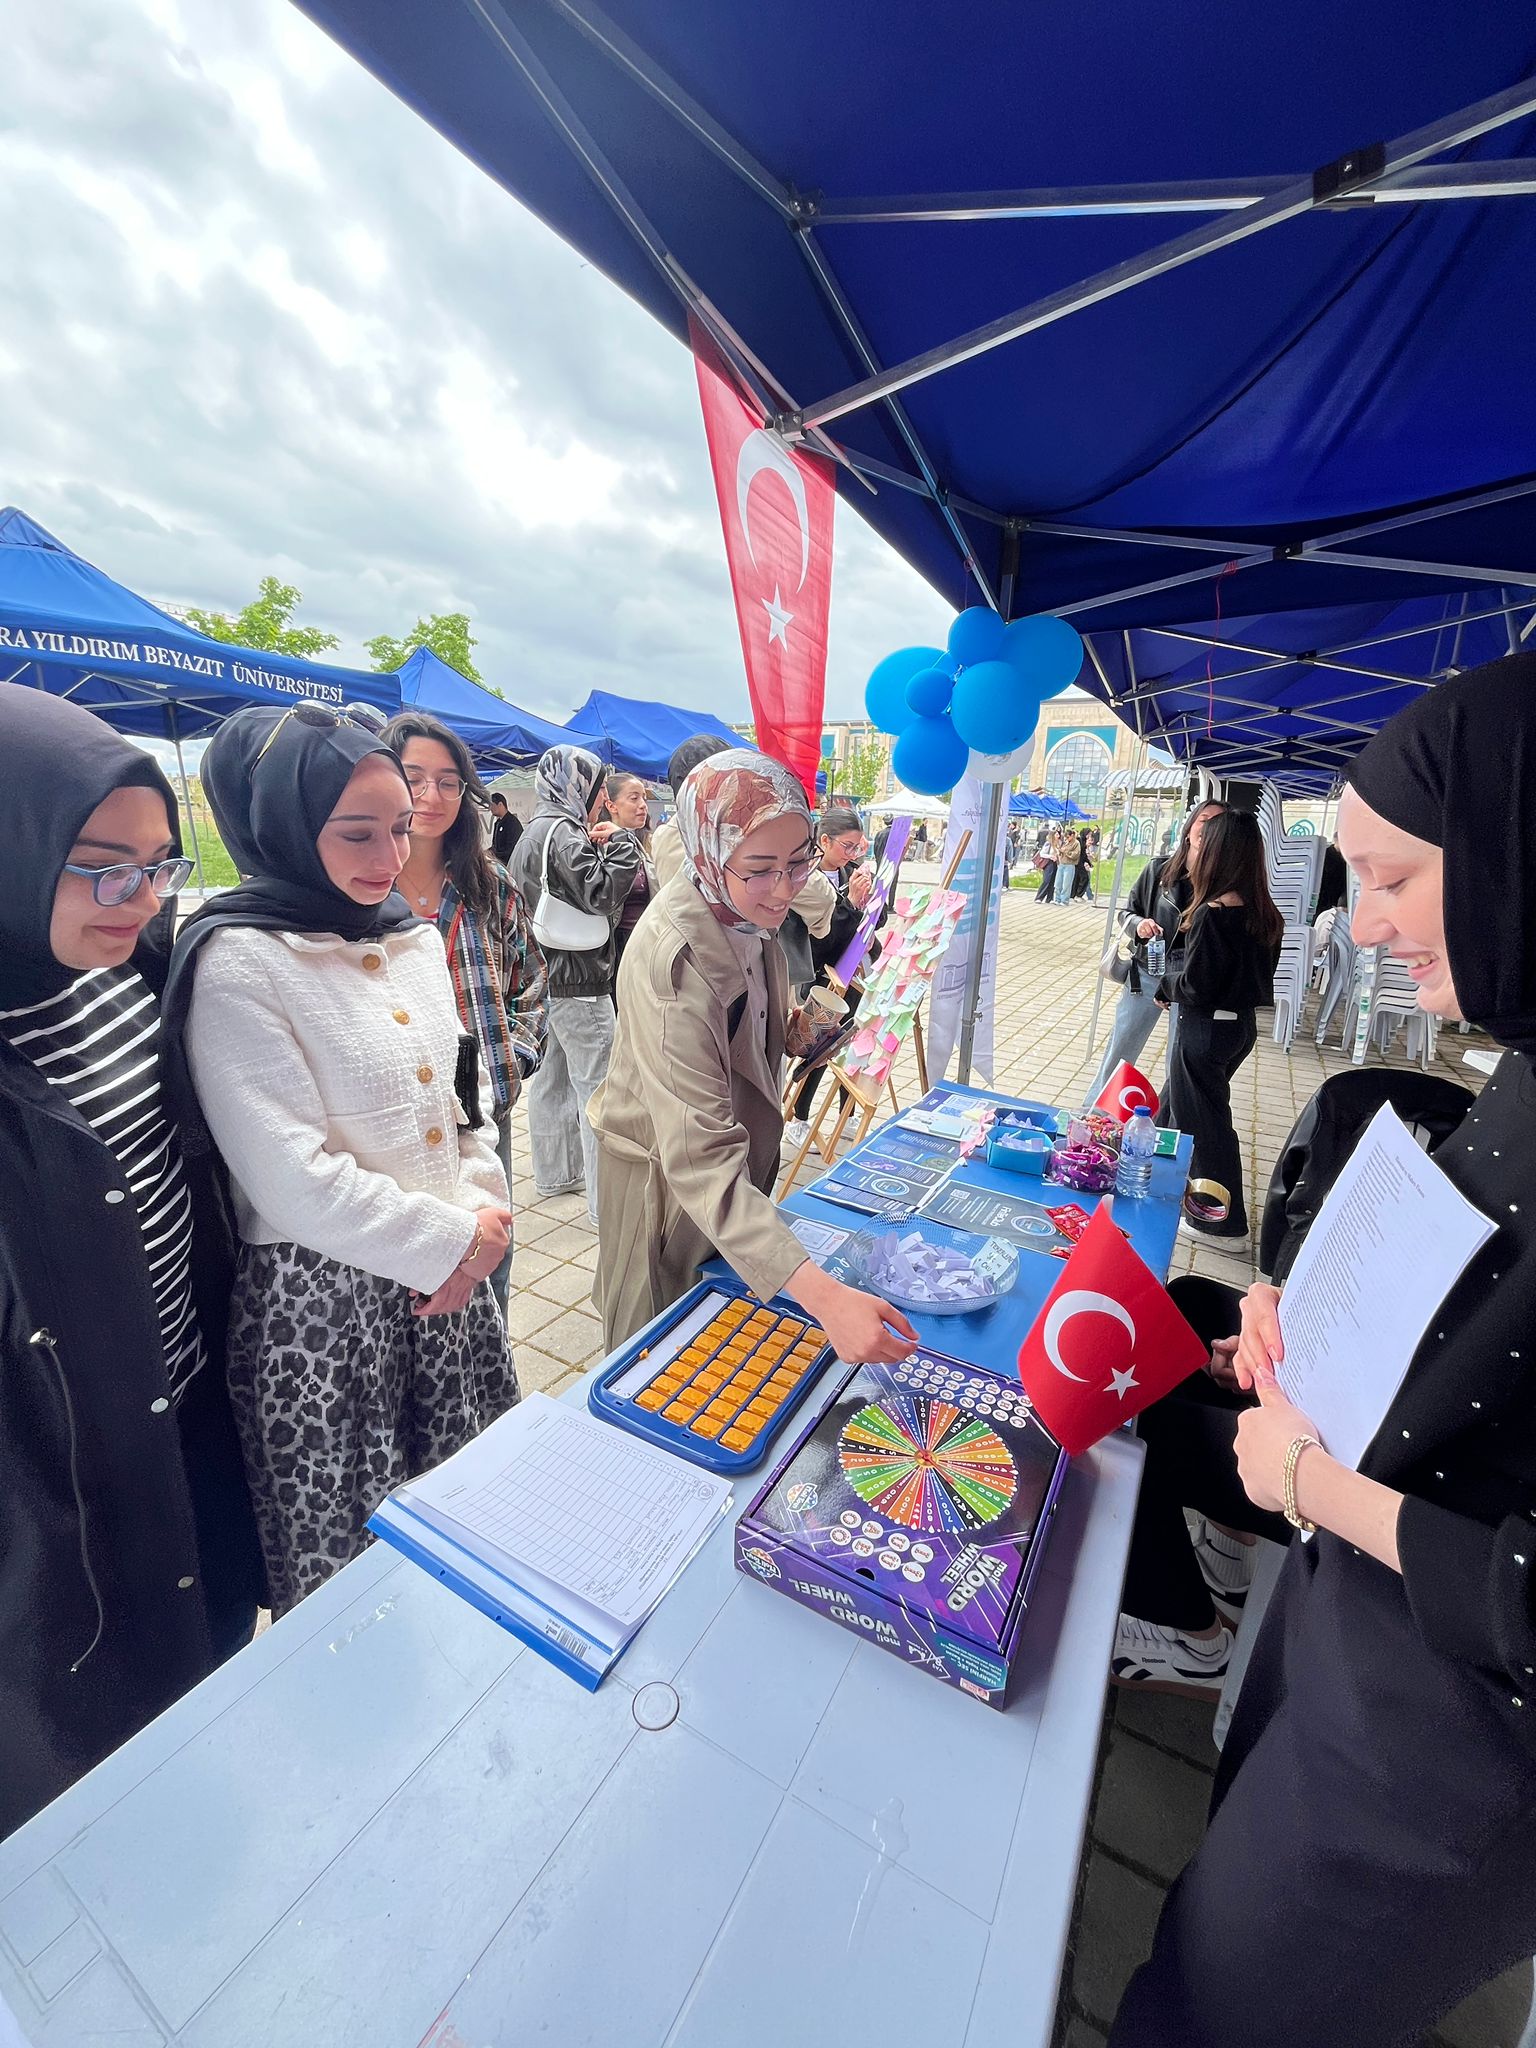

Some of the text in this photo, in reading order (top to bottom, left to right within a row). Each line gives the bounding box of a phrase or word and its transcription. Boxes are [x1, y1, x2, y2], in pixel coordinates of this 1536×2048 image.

[31, 630, 141, 662] YILDIRIM
[143, 645, 225, 678] BEYAZIT
[231, 661, 344, 703] ÜNİVERSİTESİ
[950, 1416, 967, 1433] PAS
[983, 1476, 1007, 1488] 750
[984, 1465, 1008, 1473] 450
[952, 1495, 974, 1520] PAS
[940, 1542, 982, 1584] WHEEL
[788, 1577, 857, 1607] WHEEL
[947, 1554, 1001, 1611] WORD
[830, 1605, 899, 1639] WORD
[876, 1634, 901, 1647] moli
